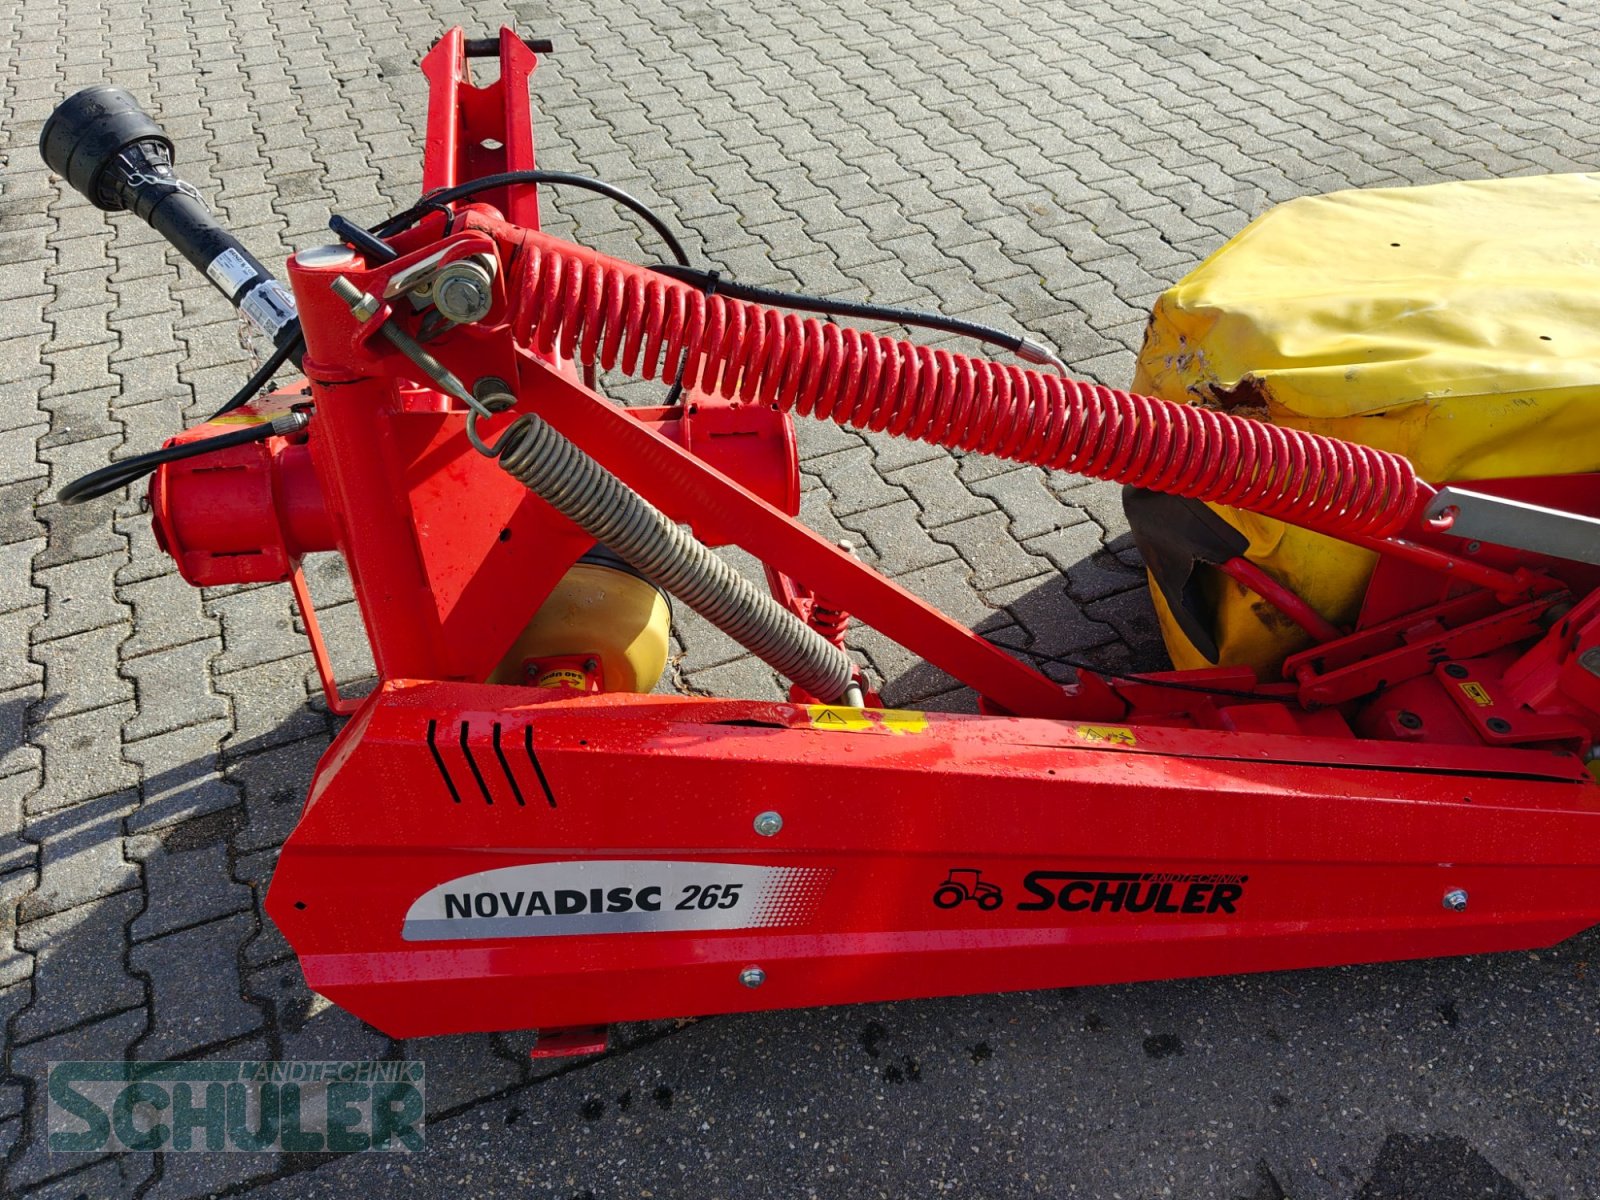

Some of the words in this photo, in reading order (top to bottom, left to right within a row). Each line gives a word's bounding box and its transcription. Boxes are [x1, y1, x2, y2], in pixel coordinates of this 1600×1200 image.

[564, 671, 583, 680] 540
[1138, 872, 1243, 884] LANDTECHNIK
[444, 886, 662, 919] NOVADISC
[675, 883, 743, 911] 265
[1016, 870, 1248, 914] SCHULER
